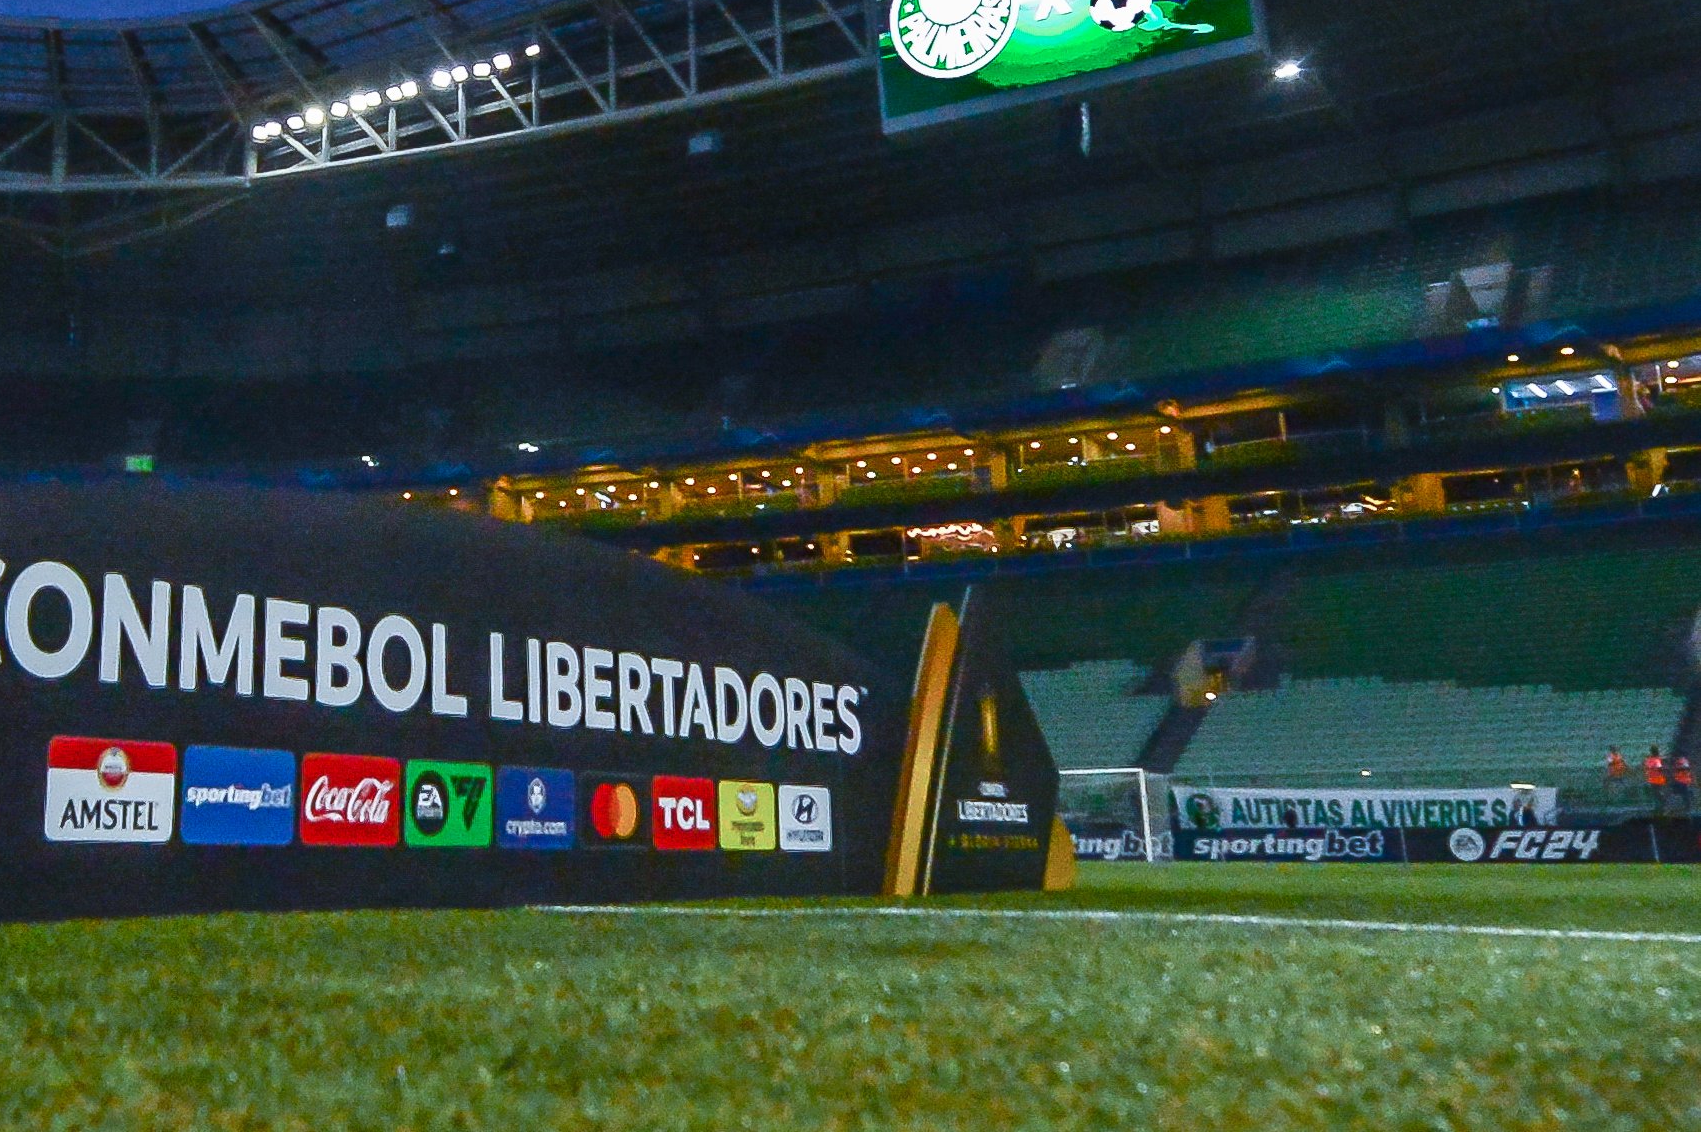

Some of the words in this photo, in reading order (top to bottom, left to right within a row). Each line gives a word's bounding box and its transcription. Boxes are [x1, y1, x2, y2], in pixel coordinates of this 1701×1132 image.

[488, 631, 862, 755] LIBERTADORES
[187, 782, 292, 810] sportingbet
[59, 798, 159, 831] AMSTEL
[658, 797, 710, 830] TCL
[1193, 829, 1384, 861] sportingbet
